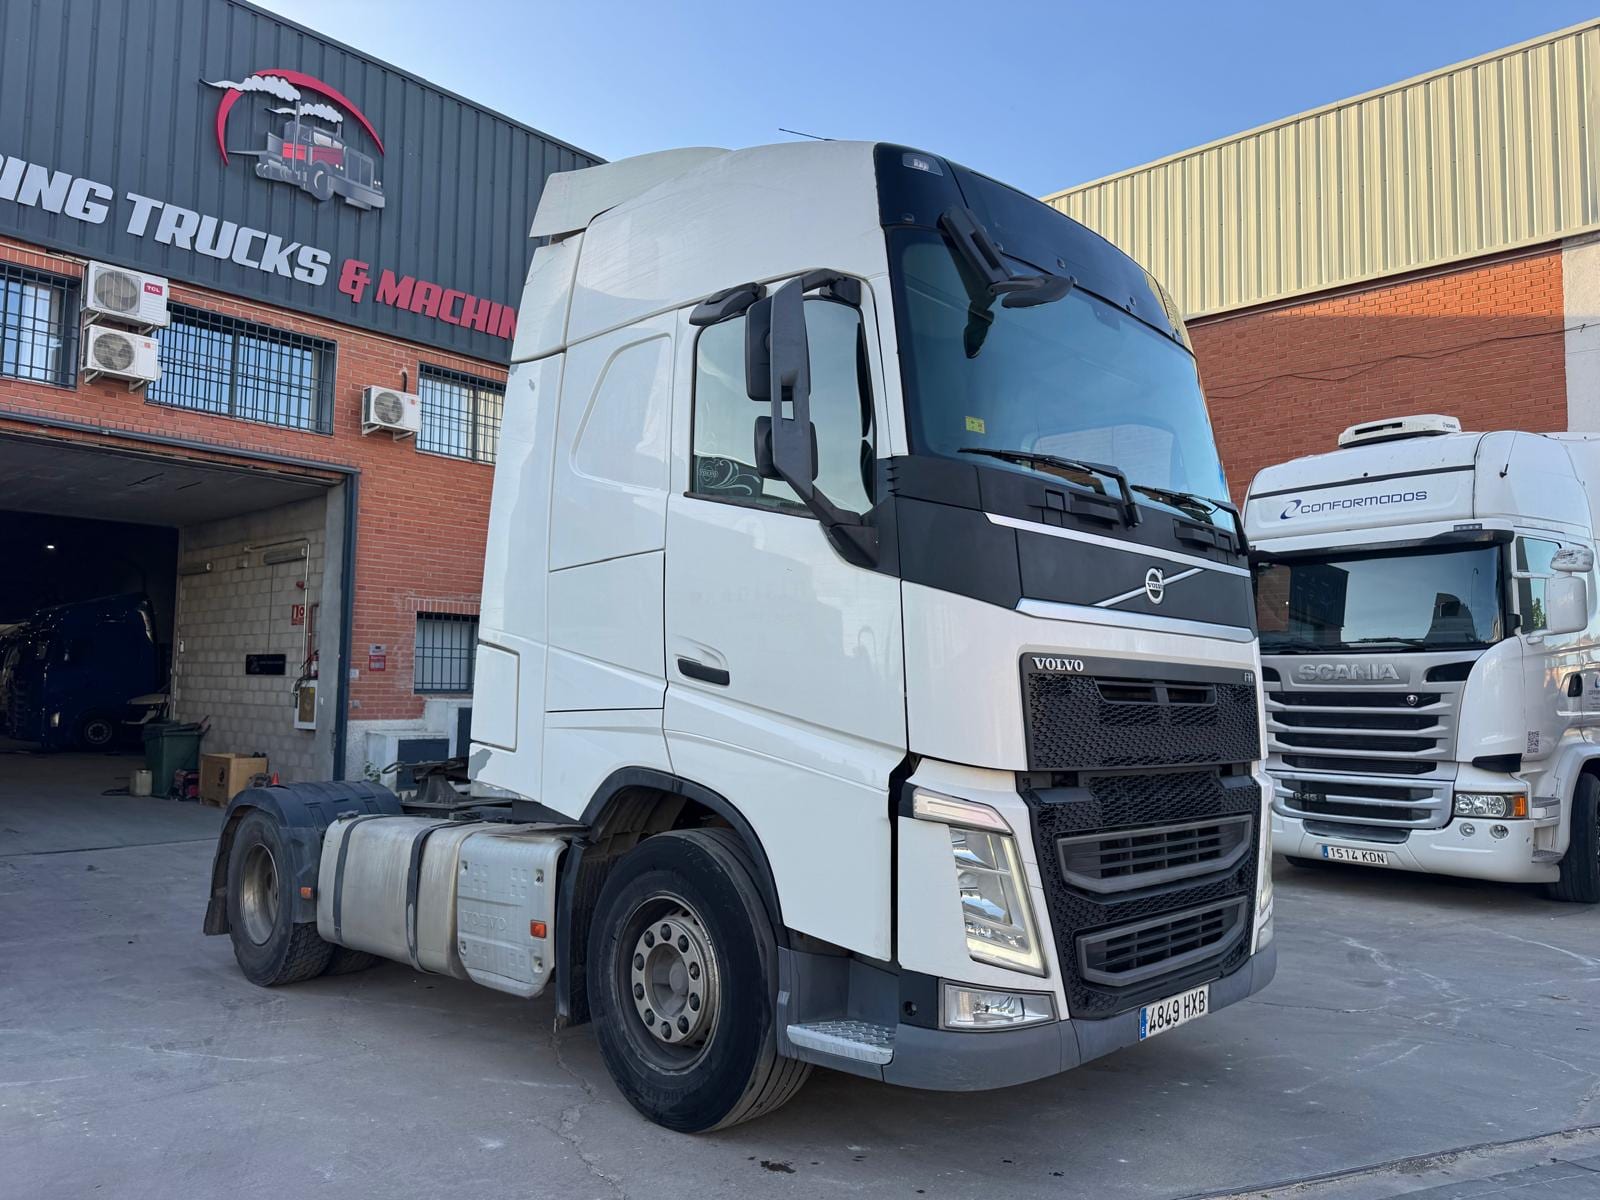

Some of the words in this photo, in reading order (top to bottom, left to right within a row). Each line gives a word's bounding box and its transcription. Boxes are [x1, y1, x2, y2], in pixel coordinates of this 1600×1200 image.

[0, 154, 114, 224] ING
[126, 192, 332, 286] TRUCKS
[338, 258, 371, 304] &
[145, 284, 161, 293] TCL
[1300, 490, 1428, 514] CONFORMADOS
[1032, 657, 1084, 672] VOLVO
[1298, 663, 1400, 681] SCANIA
[1330, 847, 1358, 860] 1514
[1361, 851, 1385, 864] KDN
[1148, 1000, 1180, 1035] 4849
[1183, 990, 1206, 1019] HXB
